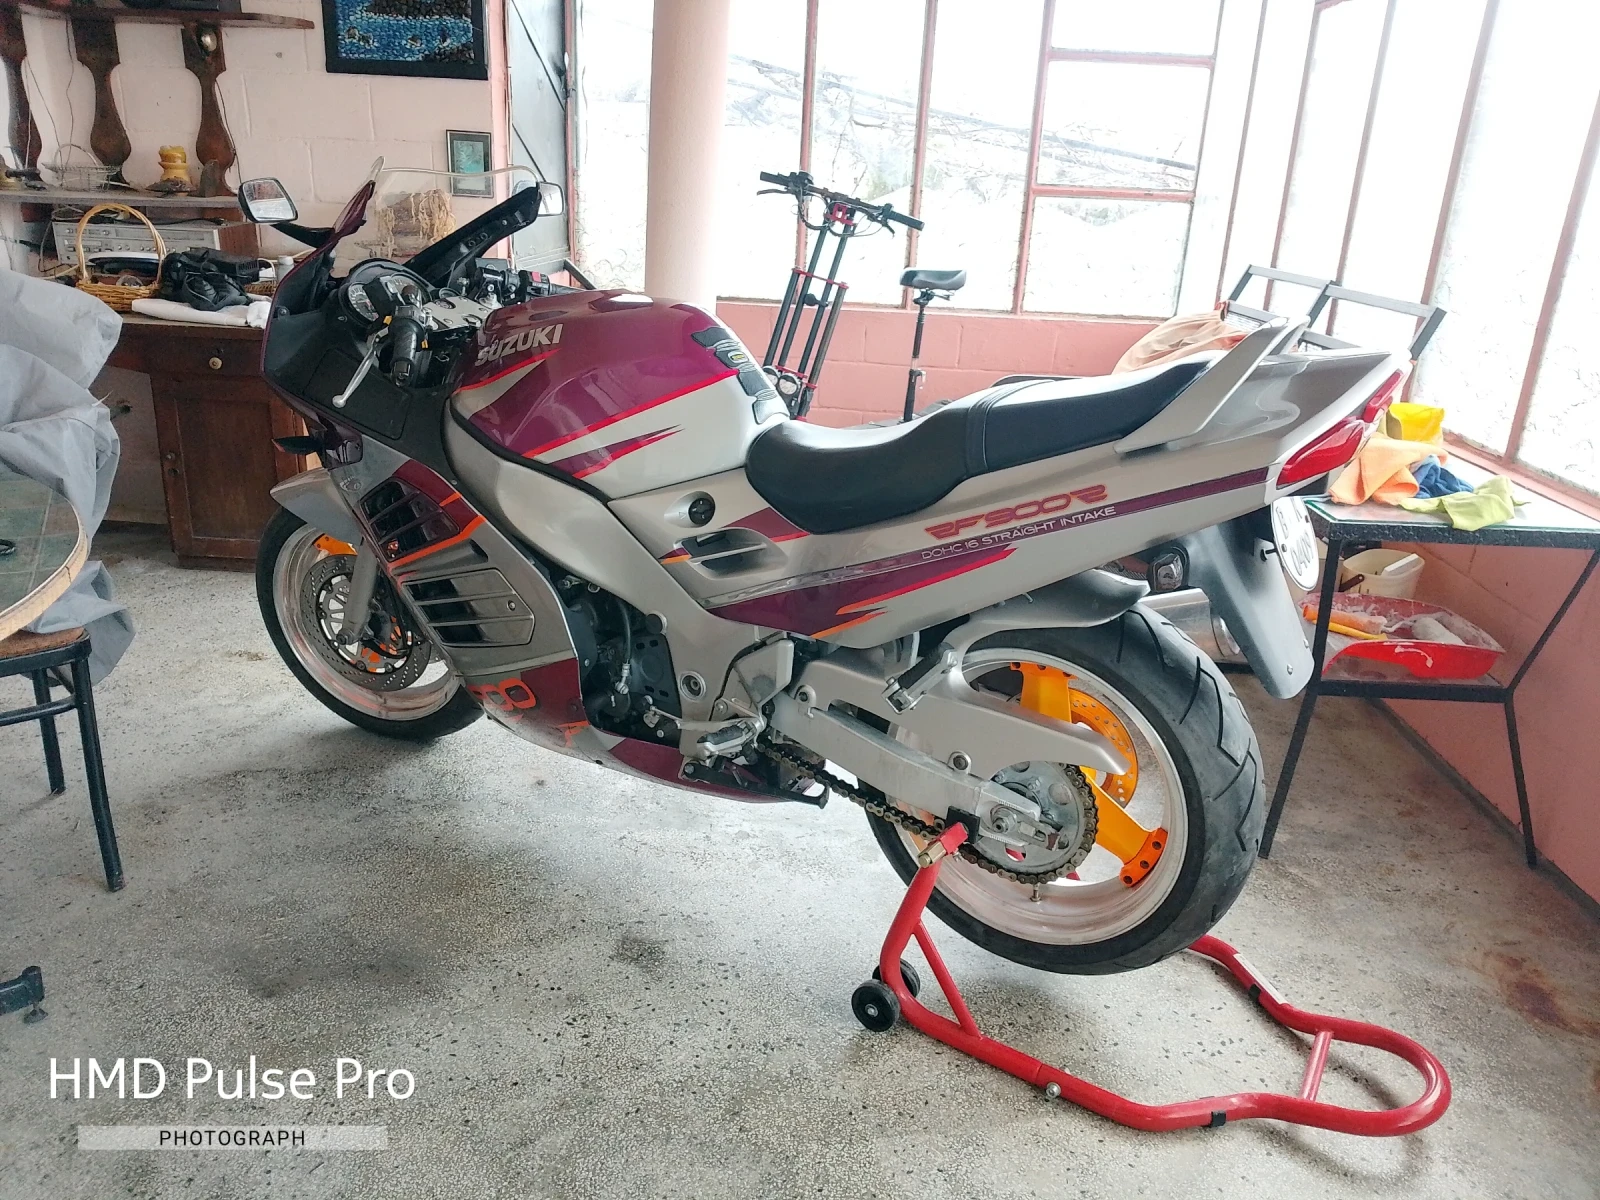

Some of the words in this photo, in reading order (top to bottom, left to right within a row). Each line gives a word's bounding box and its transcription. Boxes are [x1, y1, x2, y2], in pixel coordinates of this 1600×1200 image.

[475, 324, 563, 367] SUZUKI
[921, 543, 962, 560] DOHC
[964, 539, 979, 550] 16
[982, 521, 1056, 545] STRAIGHT
[1060, 506, 1117, 527] INTAKE
[924, 484, 1108, 540] RF900R
